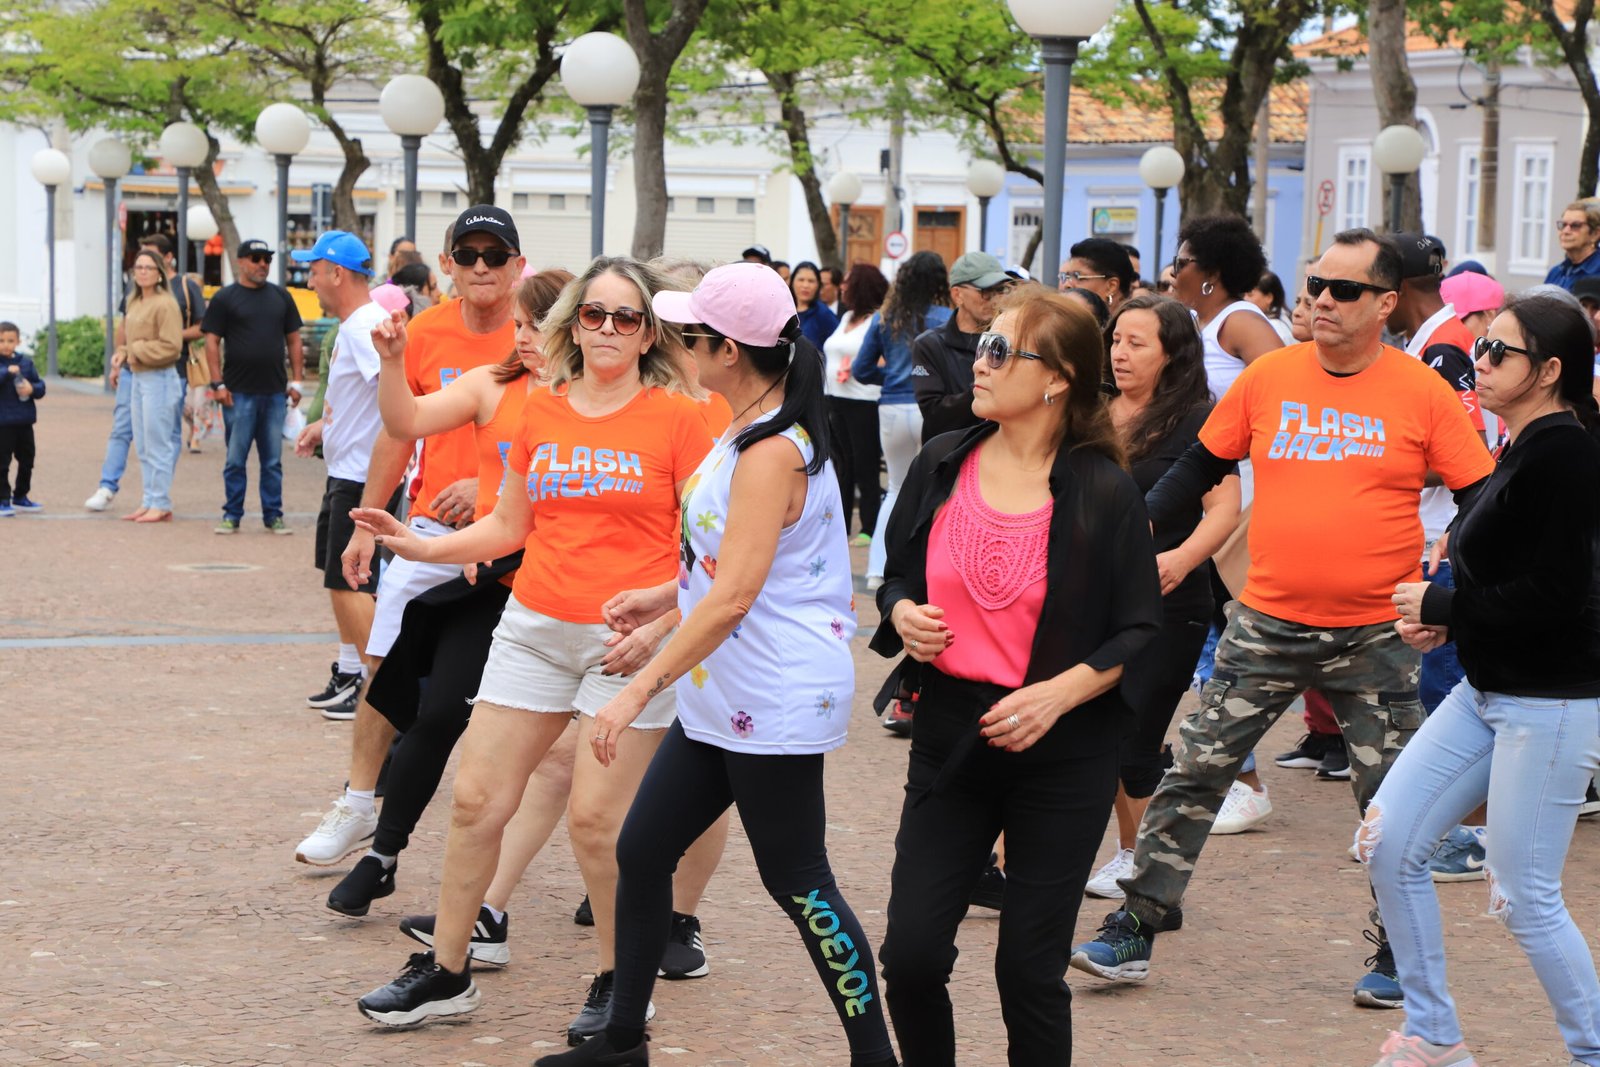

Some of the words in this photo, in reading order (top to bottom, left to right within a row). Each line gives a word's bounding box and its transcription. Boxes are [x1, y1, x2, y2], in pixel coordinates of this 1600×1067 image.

[1279, 400, 1386, 442] FLASH
[529, 442, 643, 477] FLASH
[1267, 431, 1353, 461] BACK
[527, 472, 607, 502] BACK
